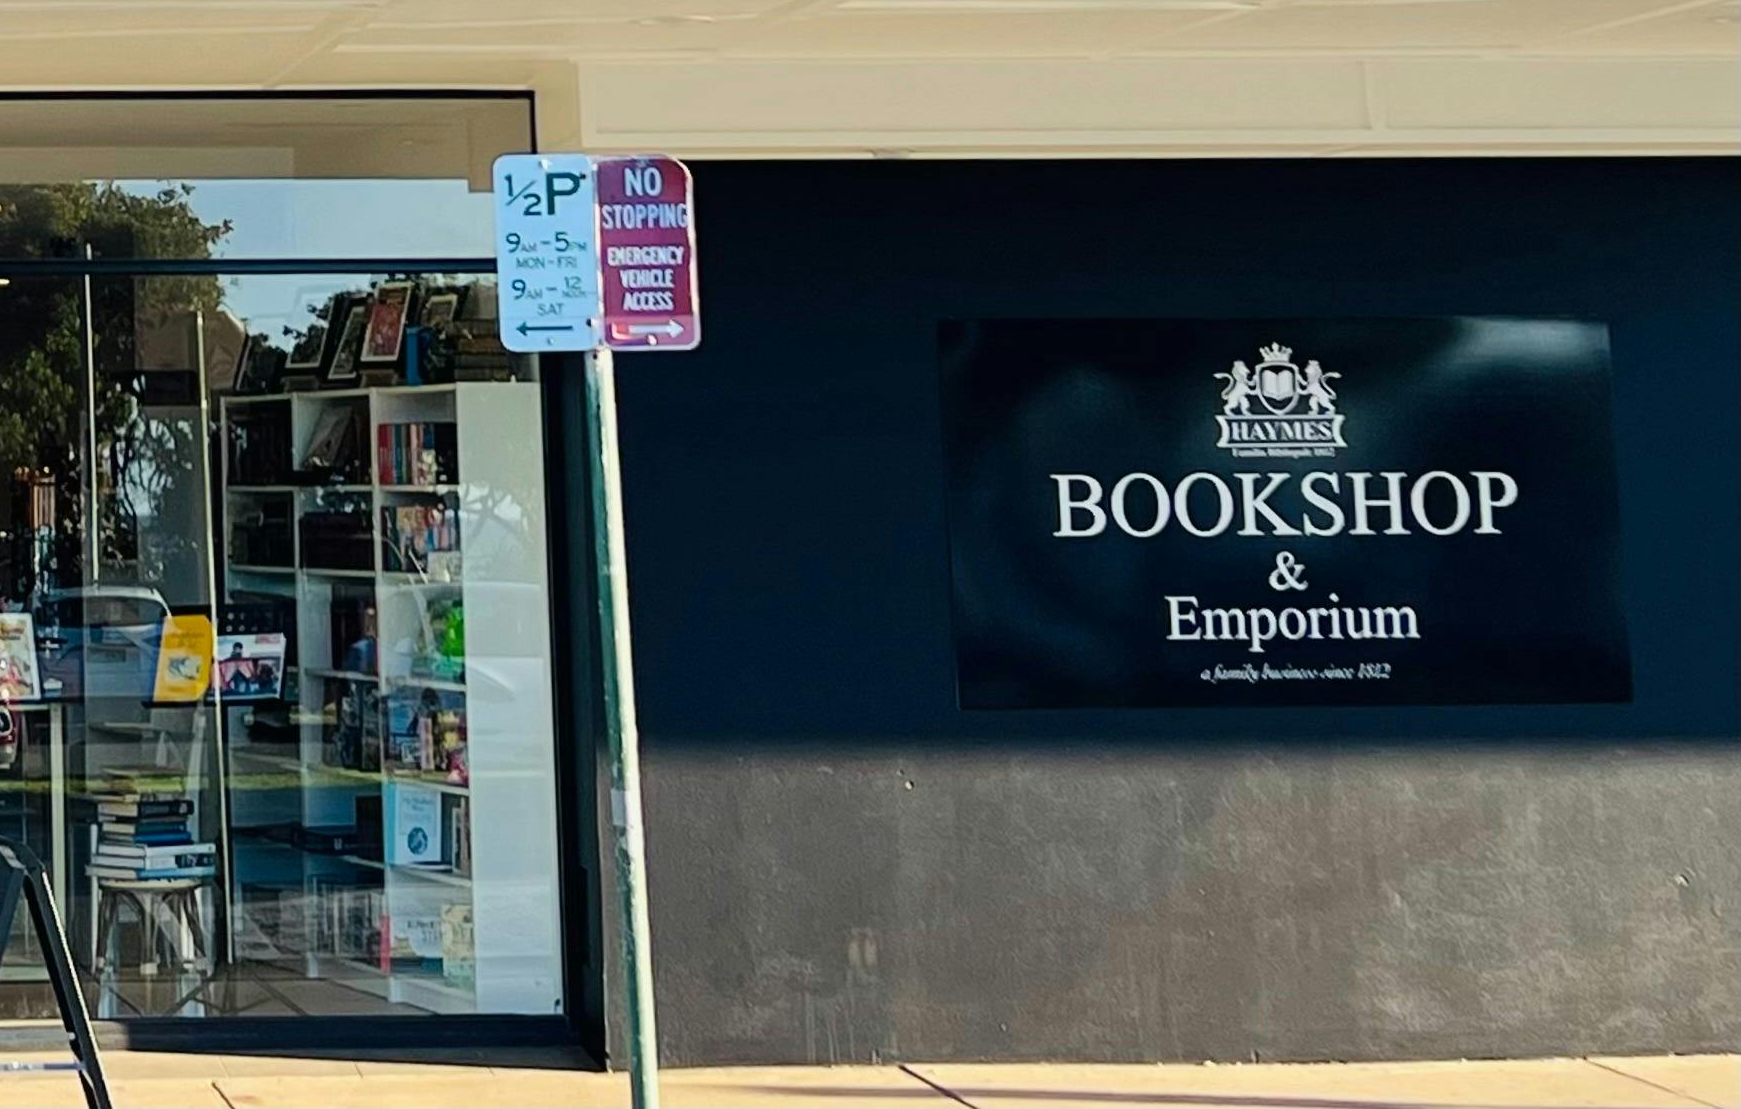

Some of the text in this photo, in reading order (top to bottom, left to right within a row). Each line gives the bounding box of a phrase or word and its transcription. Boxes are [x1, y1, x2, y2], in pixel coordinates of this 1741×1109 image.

[624, 167, 662, 197] NO
[601, 203, 687, 230] STOPPING
[607, 245, 684, 266] EMERGENCY
[620, 269, 674, 289] VEHICLE
[537, 302, 564, 316] SAT
[623, 292, 673, 311] ACCESS
[1231, 421, 1333, 441] HAYMES
[1049, 470, 1518, 538] BOOKSHOP
[1268, 550, 1308, 591] &
[1164, 594, 1420, 652] Emporium
